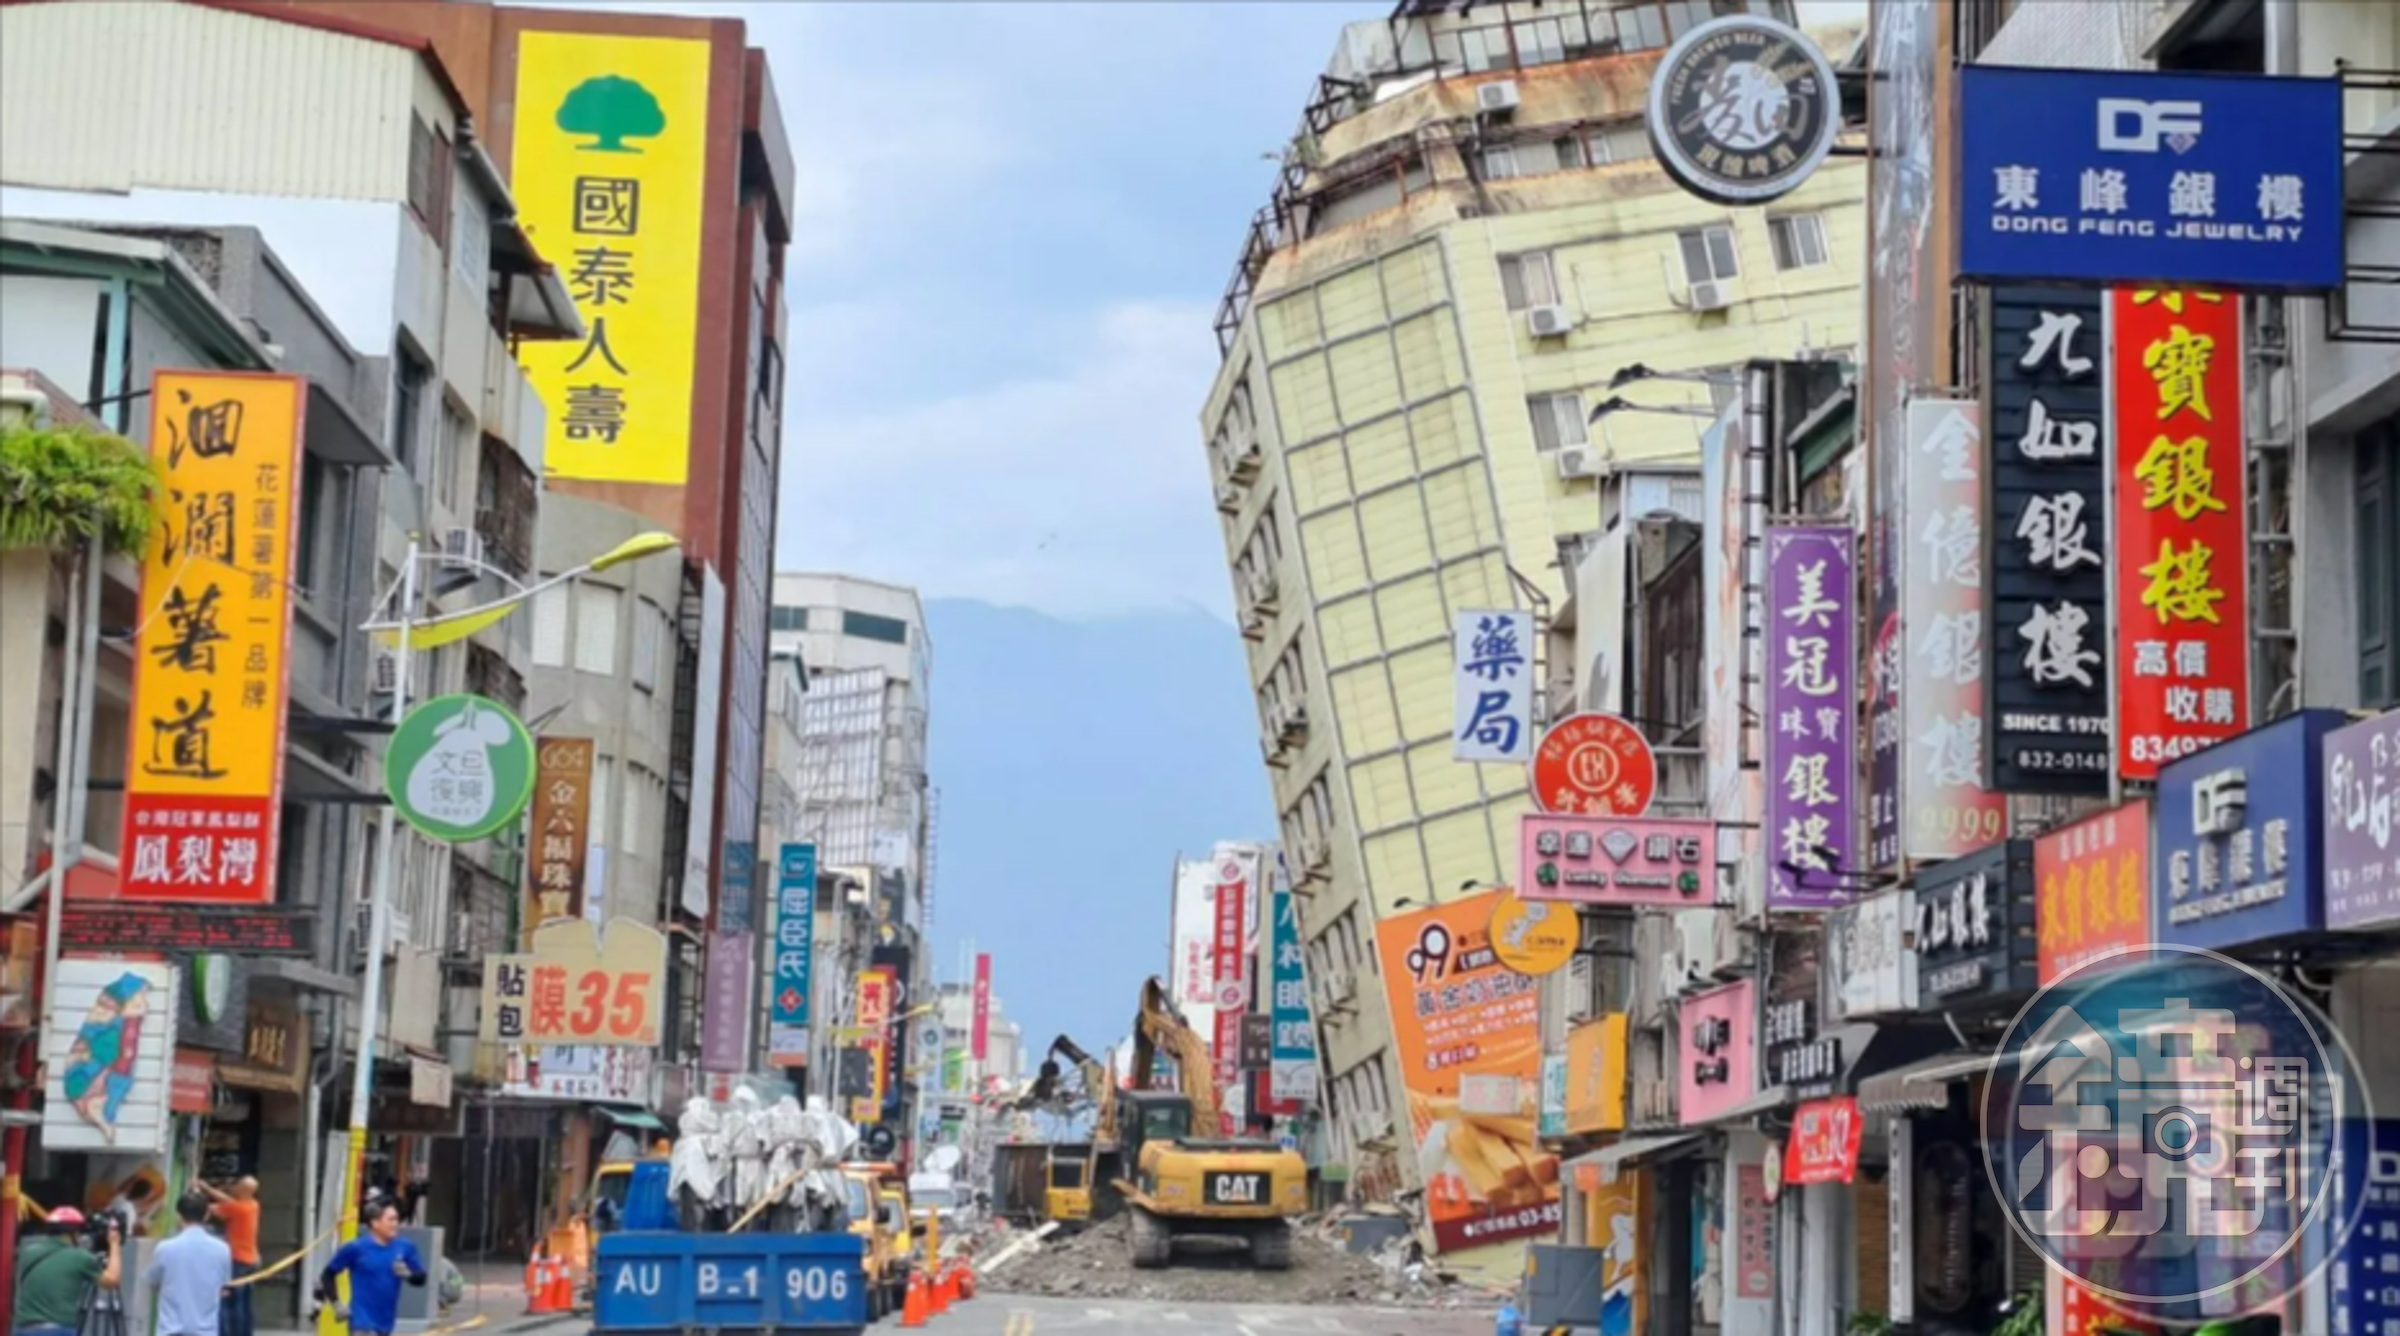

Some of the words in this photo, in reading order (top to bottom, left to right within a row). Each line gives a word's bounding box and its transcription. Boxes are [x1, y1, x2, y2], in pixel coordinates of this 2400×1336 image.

[2096, 98, 2202, 152] DF
[1992, 164, 2305, 221] 東峰銀樓
[1992, 215, 2069, 234] DONG
[2077, 219, 2155, 237] FENG
[2165, 223, 2304, 242] JEWELRY
[561, 176, 640, 444] 國泰人壽
[2016, 310, 2102, 688] 九如銀樓
[143, 389, 244, 780] 洄瀾薯道
[241, 463, 280, 709] 花蓮薯第一品牌
[1917, 407, 1983, 791] 金億銀樓
[1781, 559, 1841, 697] 美冠
[1460, 615, 1525, 754] 藥局
[2133, 639, 2207, 677] 高價
[2003, 713, 2062, 733] SINCE
[2165, 686, 2235, 725] 收購
[2019, 750, 2108, 770] 832-0148
[1917, 806, 2002, 844] 9999
[129, 834, 258, 886] 鳳梨灣
[495, 963, 526, 1038] 貼包
[529, 966, 650, 1037] 膜35
[1214, 1174, 1261, 1201] CAT
[614, 1263, 661, 1295] AU
[699, 1263, 758, 1297] B-1
[787, 1267, 847, 1299] 906
